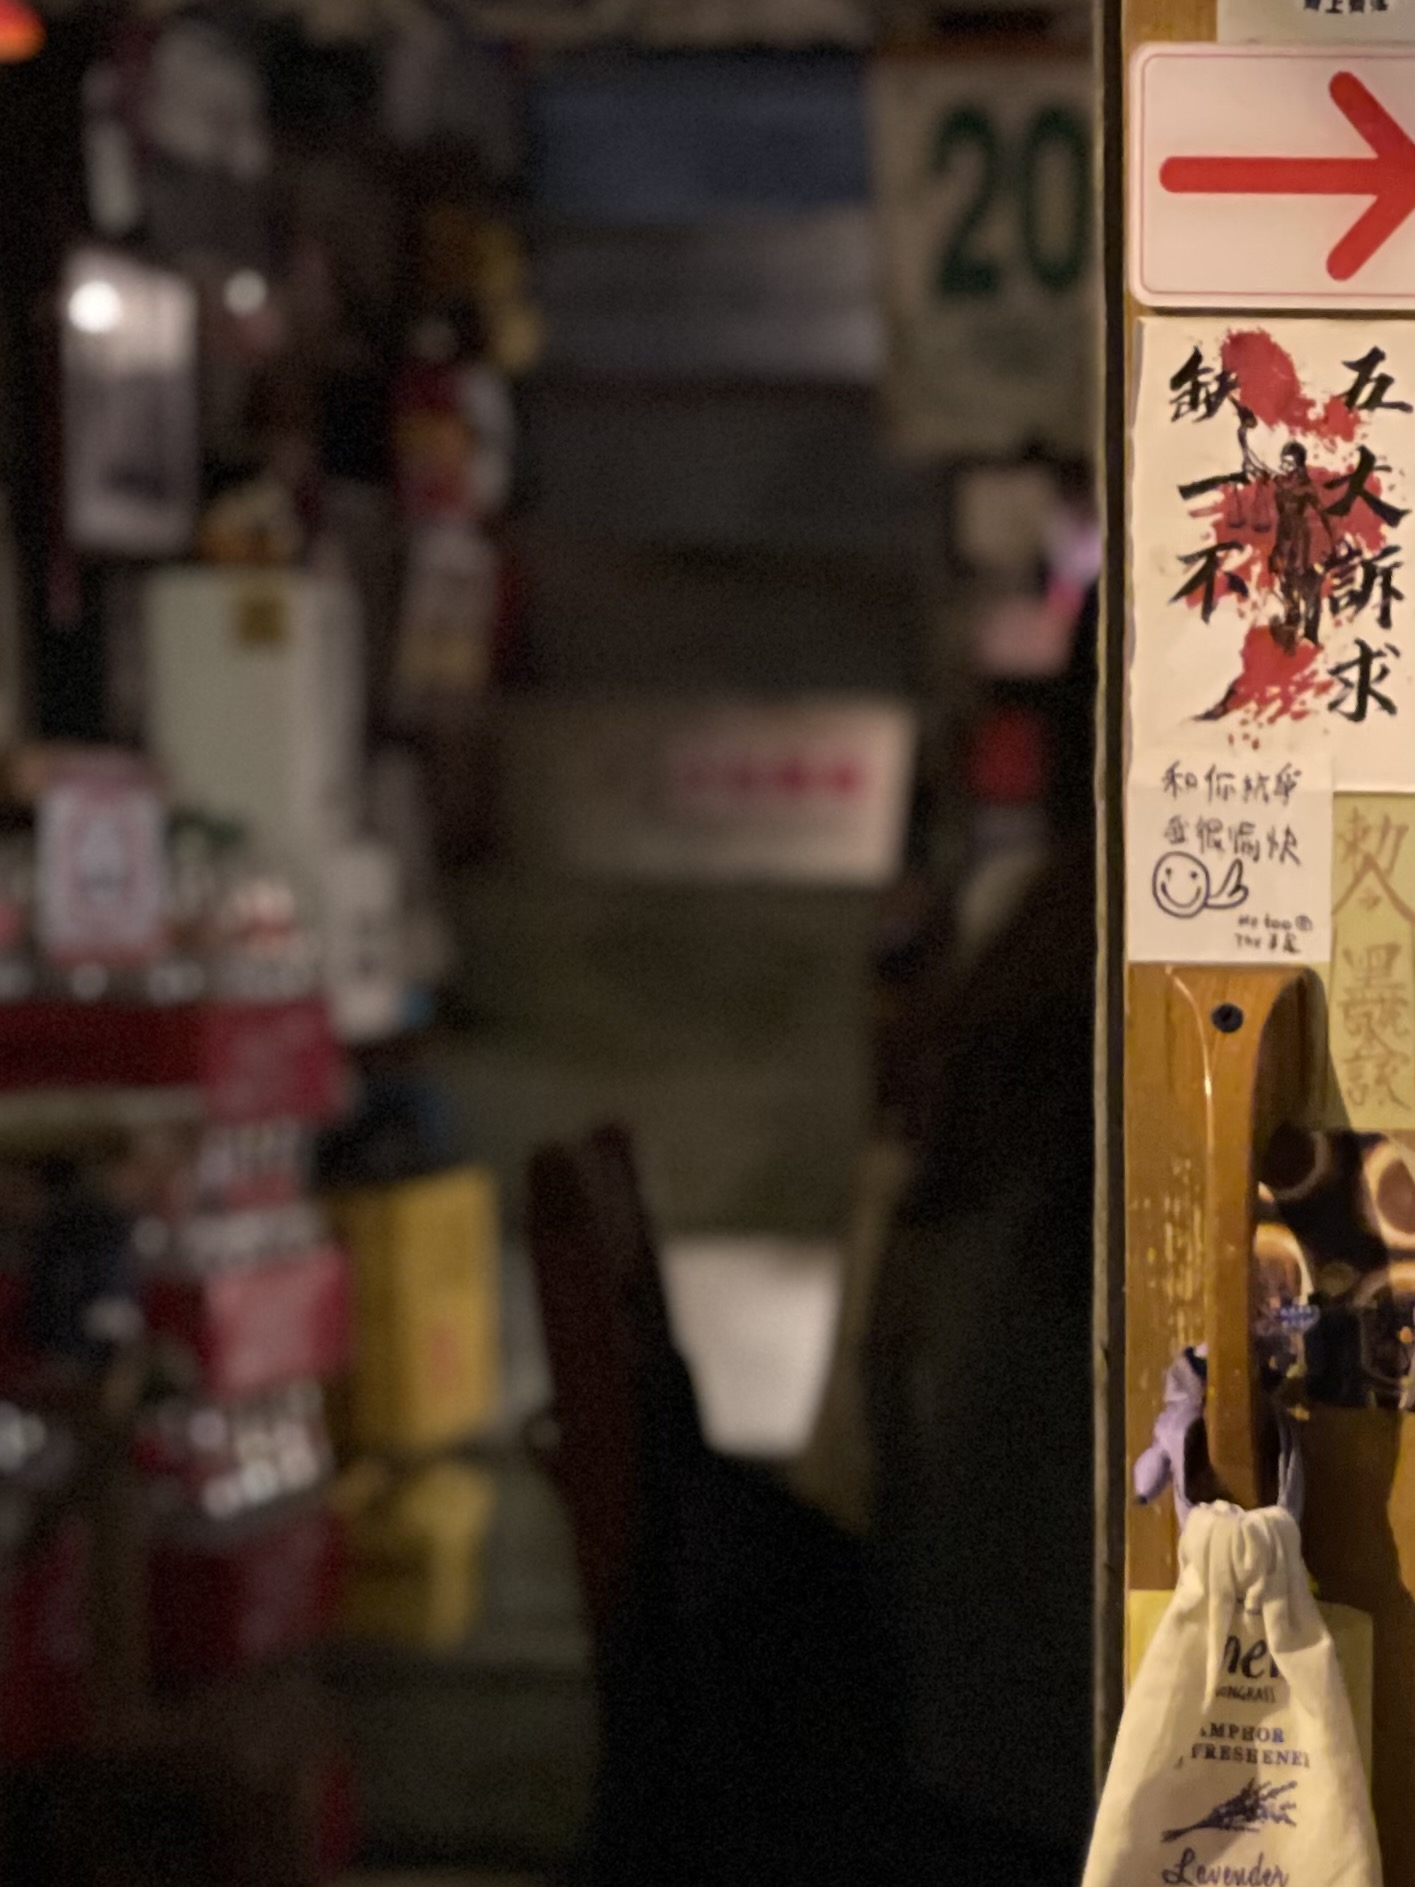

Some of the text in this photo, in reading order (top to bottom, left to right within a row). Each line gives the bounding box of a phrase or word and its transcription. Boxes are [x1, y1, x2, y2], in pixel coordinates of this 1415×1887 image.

[930, 105, 1094, 294] 20
[1324, 346, 1414, 722] 五大訴求
[1192, 1742, 1311, 1769] FRESHENE
